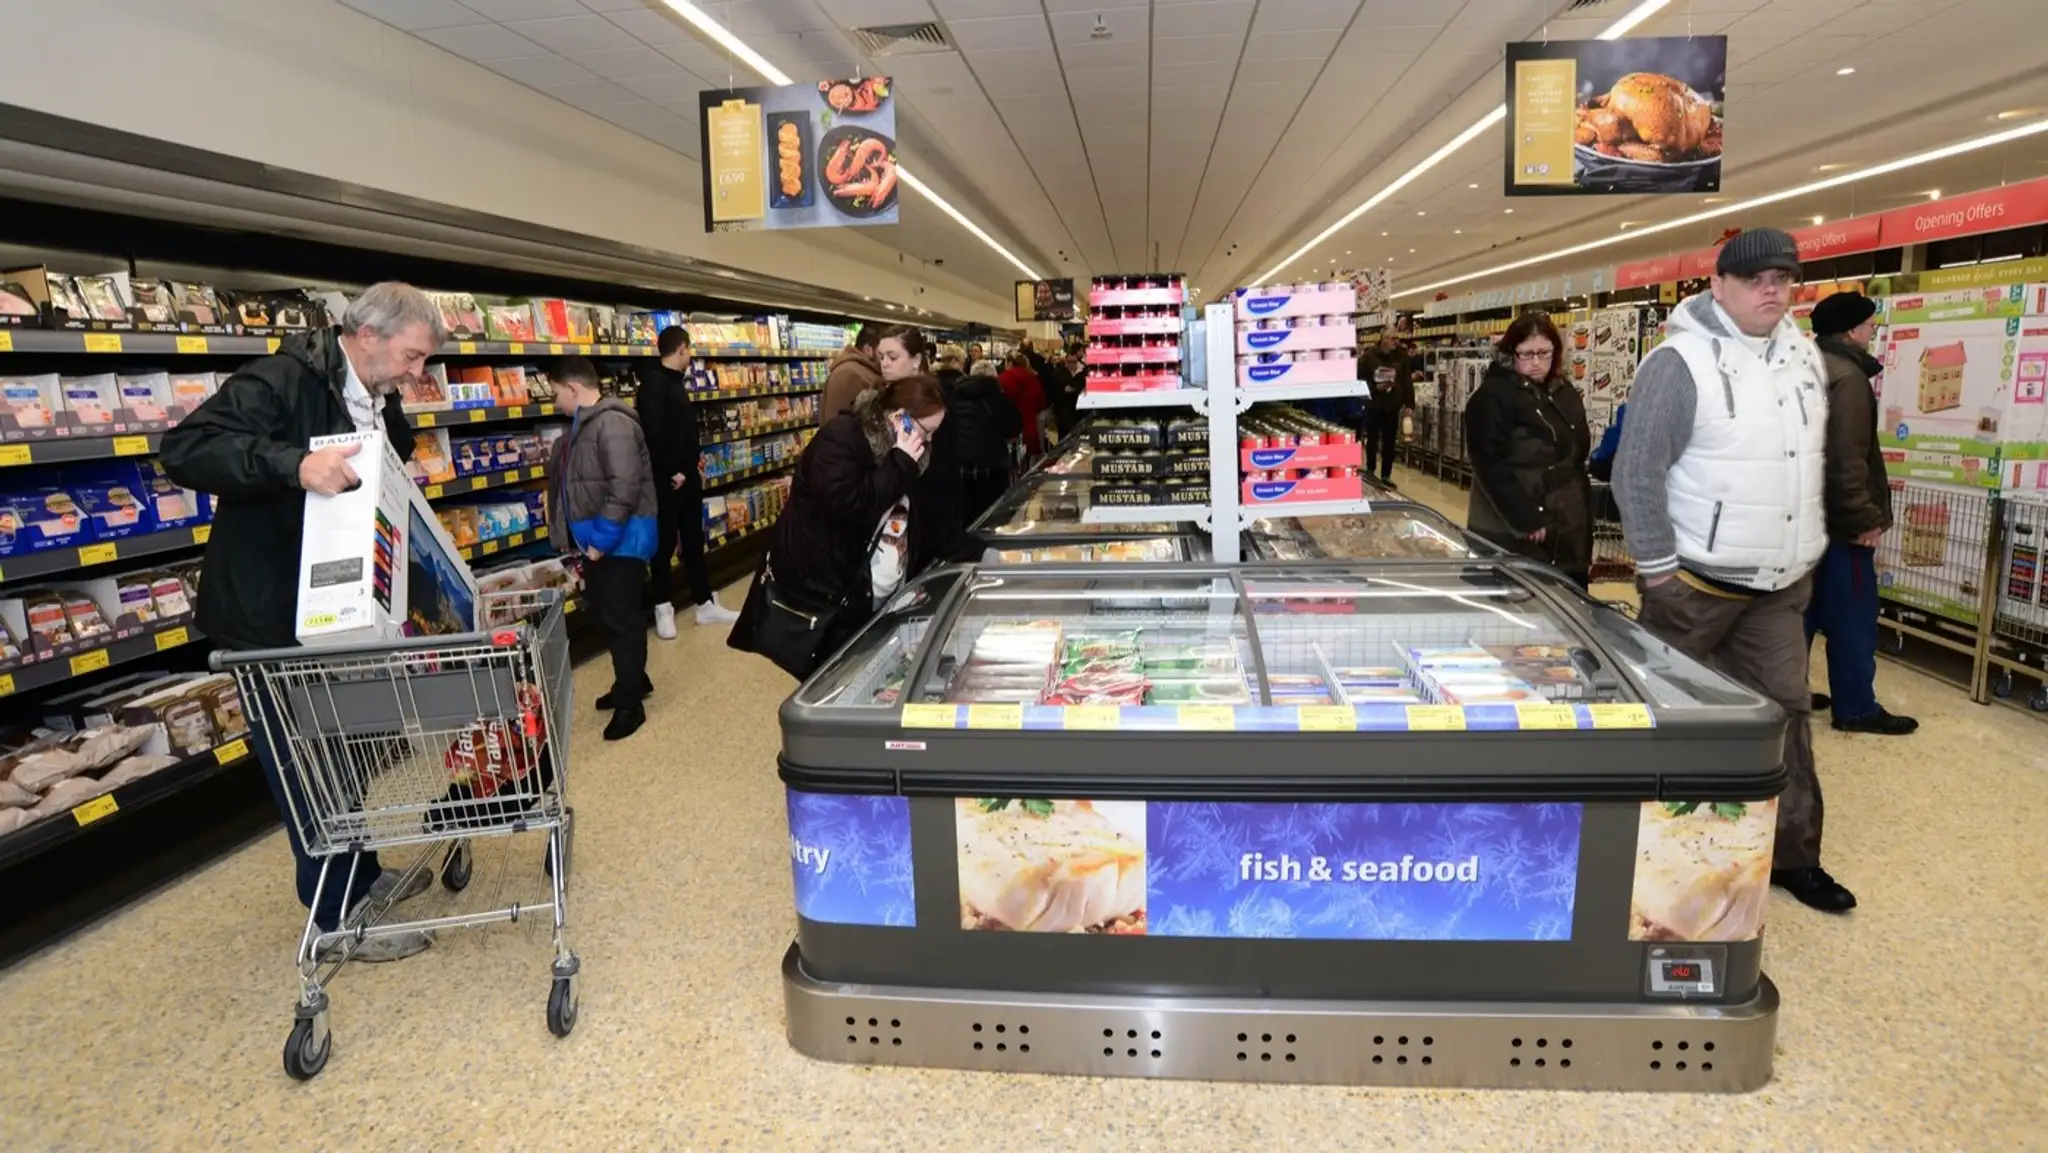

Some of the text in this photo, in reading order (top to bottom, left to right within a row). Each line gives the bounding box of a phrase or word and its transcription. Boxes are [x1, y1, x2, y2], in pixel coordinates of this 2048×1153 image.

[1915, 202, 2005, 232] Opening Offers
[1821, 232, 1848, 247] Offers
[1098, 433, 1151, 445] MUSTARD
[1101, 463, 1153, 474] MUSTARD
[1098, 493, 1151, 504] MUSTARD
[1239, 852, 1480, 883] fish & seafood
